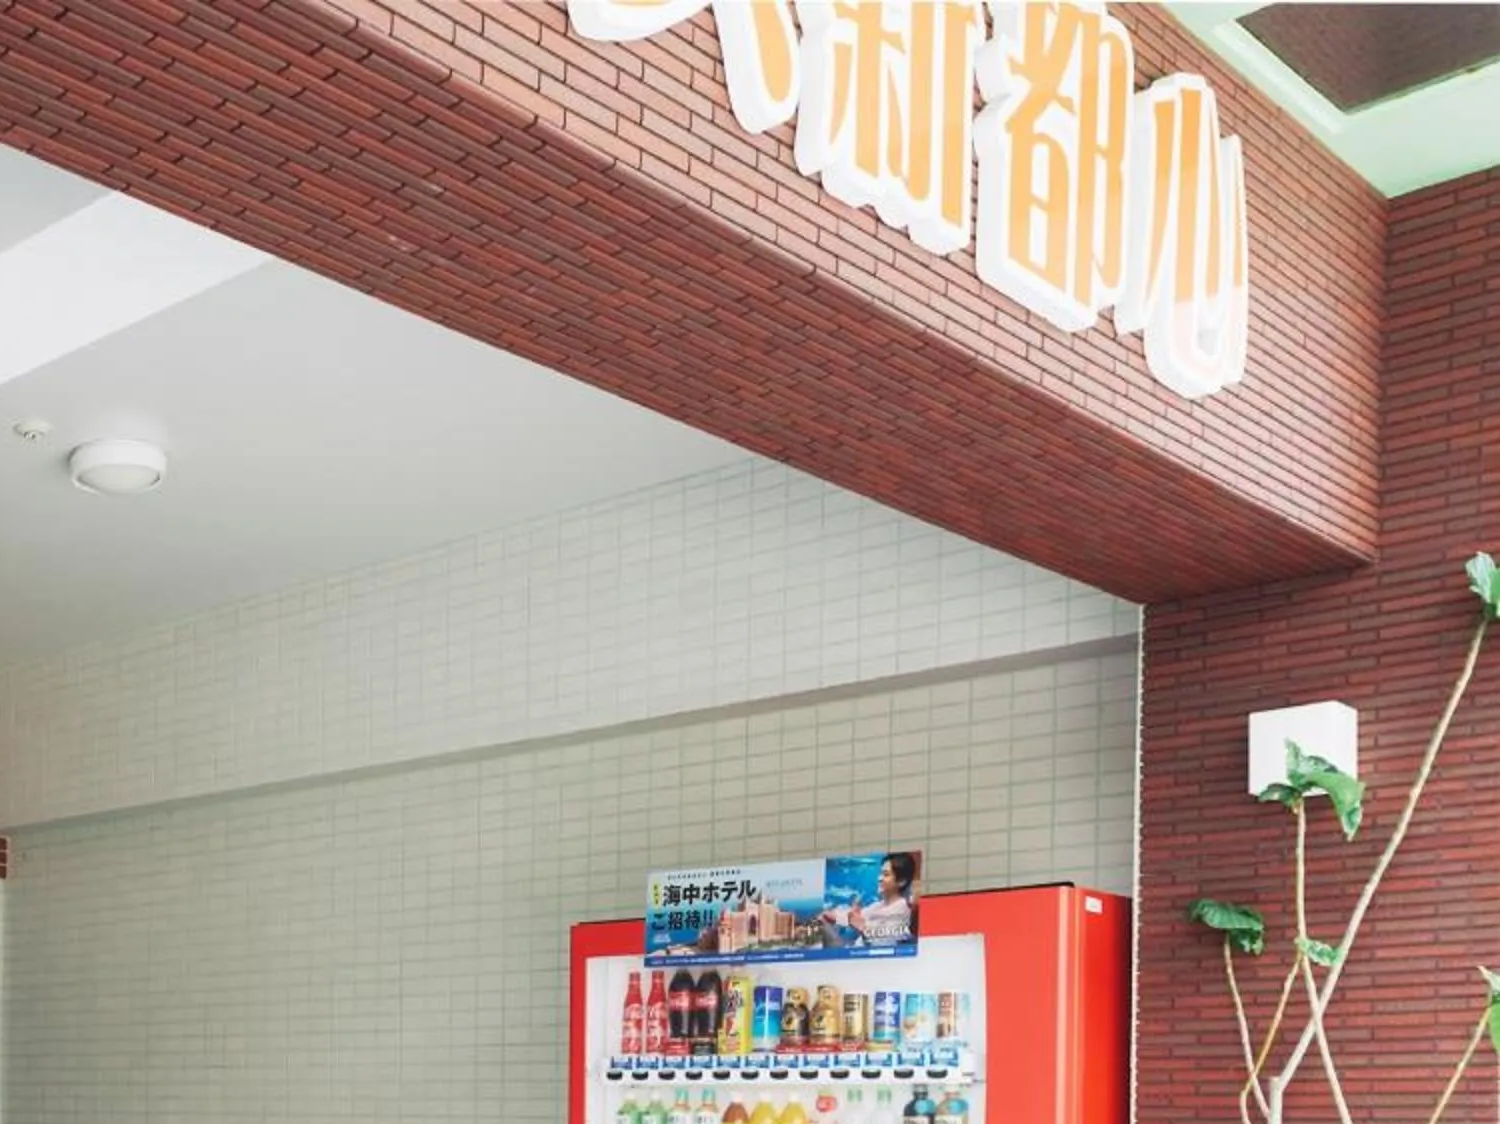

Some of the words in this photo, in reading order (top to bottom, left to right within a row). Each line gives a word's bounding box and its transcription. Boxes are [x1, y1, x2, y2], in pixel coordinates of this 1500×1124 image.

[663, 880, 757, 906] 海中ホテル
